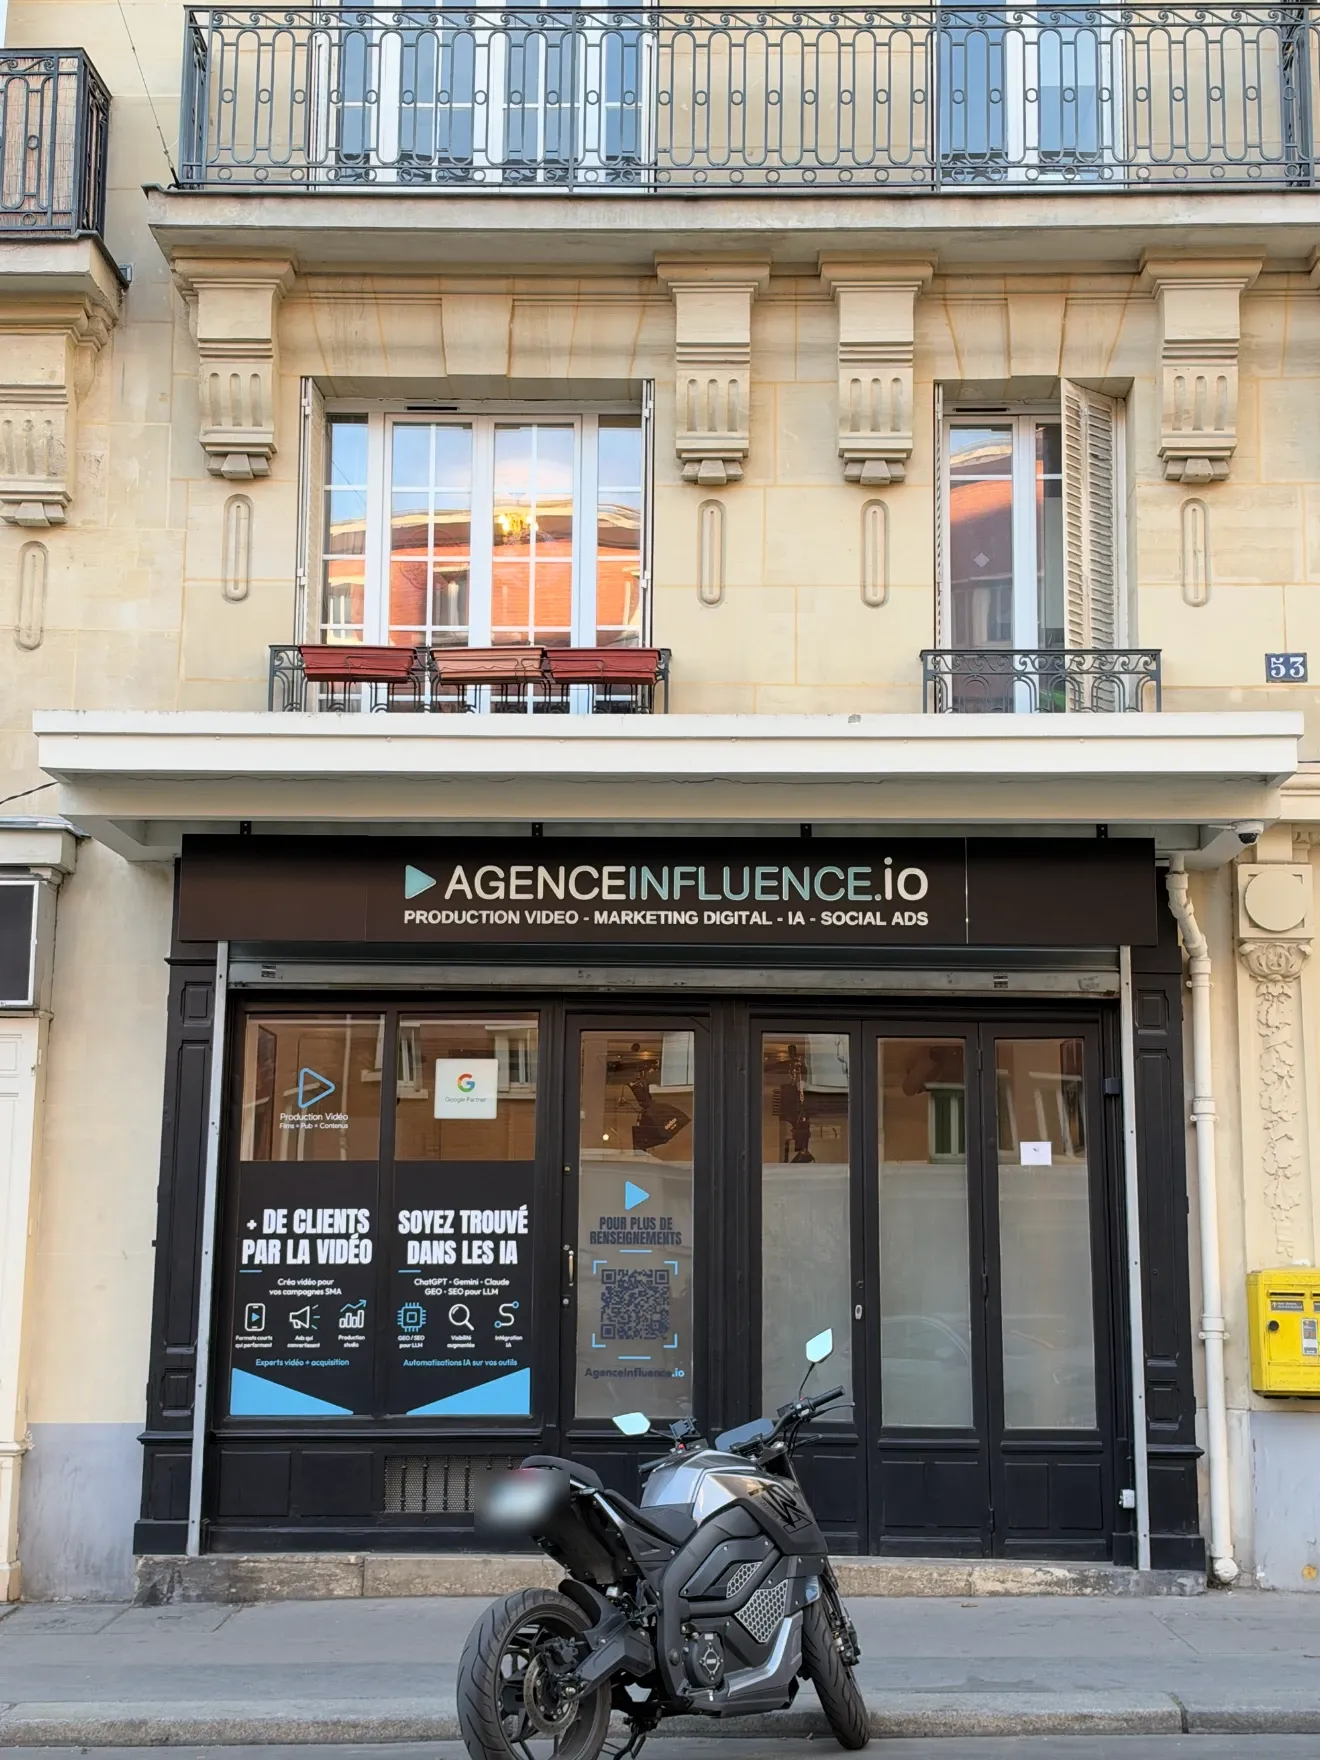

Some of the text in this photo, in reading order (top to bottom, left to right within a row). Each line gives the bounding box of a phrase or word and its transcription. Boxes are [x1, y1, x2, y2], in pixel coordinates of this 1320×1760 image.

[1270, 657, 1305, 678] 53
[404, 910, 520, 924] PRODUCTION
[525, 910, 579, 924] VIDEO
[594, 910, 698, 925] MARKETING
[703, 911, 773, 925] DIGITAL
[788, 911, 805, 925] IA
[820, 911, 886, 925] SOCIAL
[891, 911, 929, 925] ADS
[444, 1096, 466, 1104] Google
[280, 1112, 349, 1121] Production Vidéo
[263, 1208, 288, 1234] DE
[293, 1208, 370, 1234] CLIENTS
[398, 1204, 528, 1234] SOYEZ TROUVÉ
[599, 1217, 673, 1230] POUR PLUS DE
[589, 1231, 682, 1245] RENSEIGNEMENTS
[241, 1233, 373, 1265] PAR LA VIDÉO
[407, 1240, 518, 1265] DANS LES IA
[277, 1278, 334, 1287] Créa vidéo pour
[414, 1278, 510, 1286] ChatGPT Gemini Claude
[282, 1289, 324, 1297] campagnes
[464, 1289, 482, 1297] pour
[255, 1359, 283, 1367] Experts
[284, 1358, 304, 1366] vidéo
[311, 1358, 350, 1367] acquisition
[403, 1358, 462, 1366] Automatisations
[498, 1358, 518, 1366] outils
